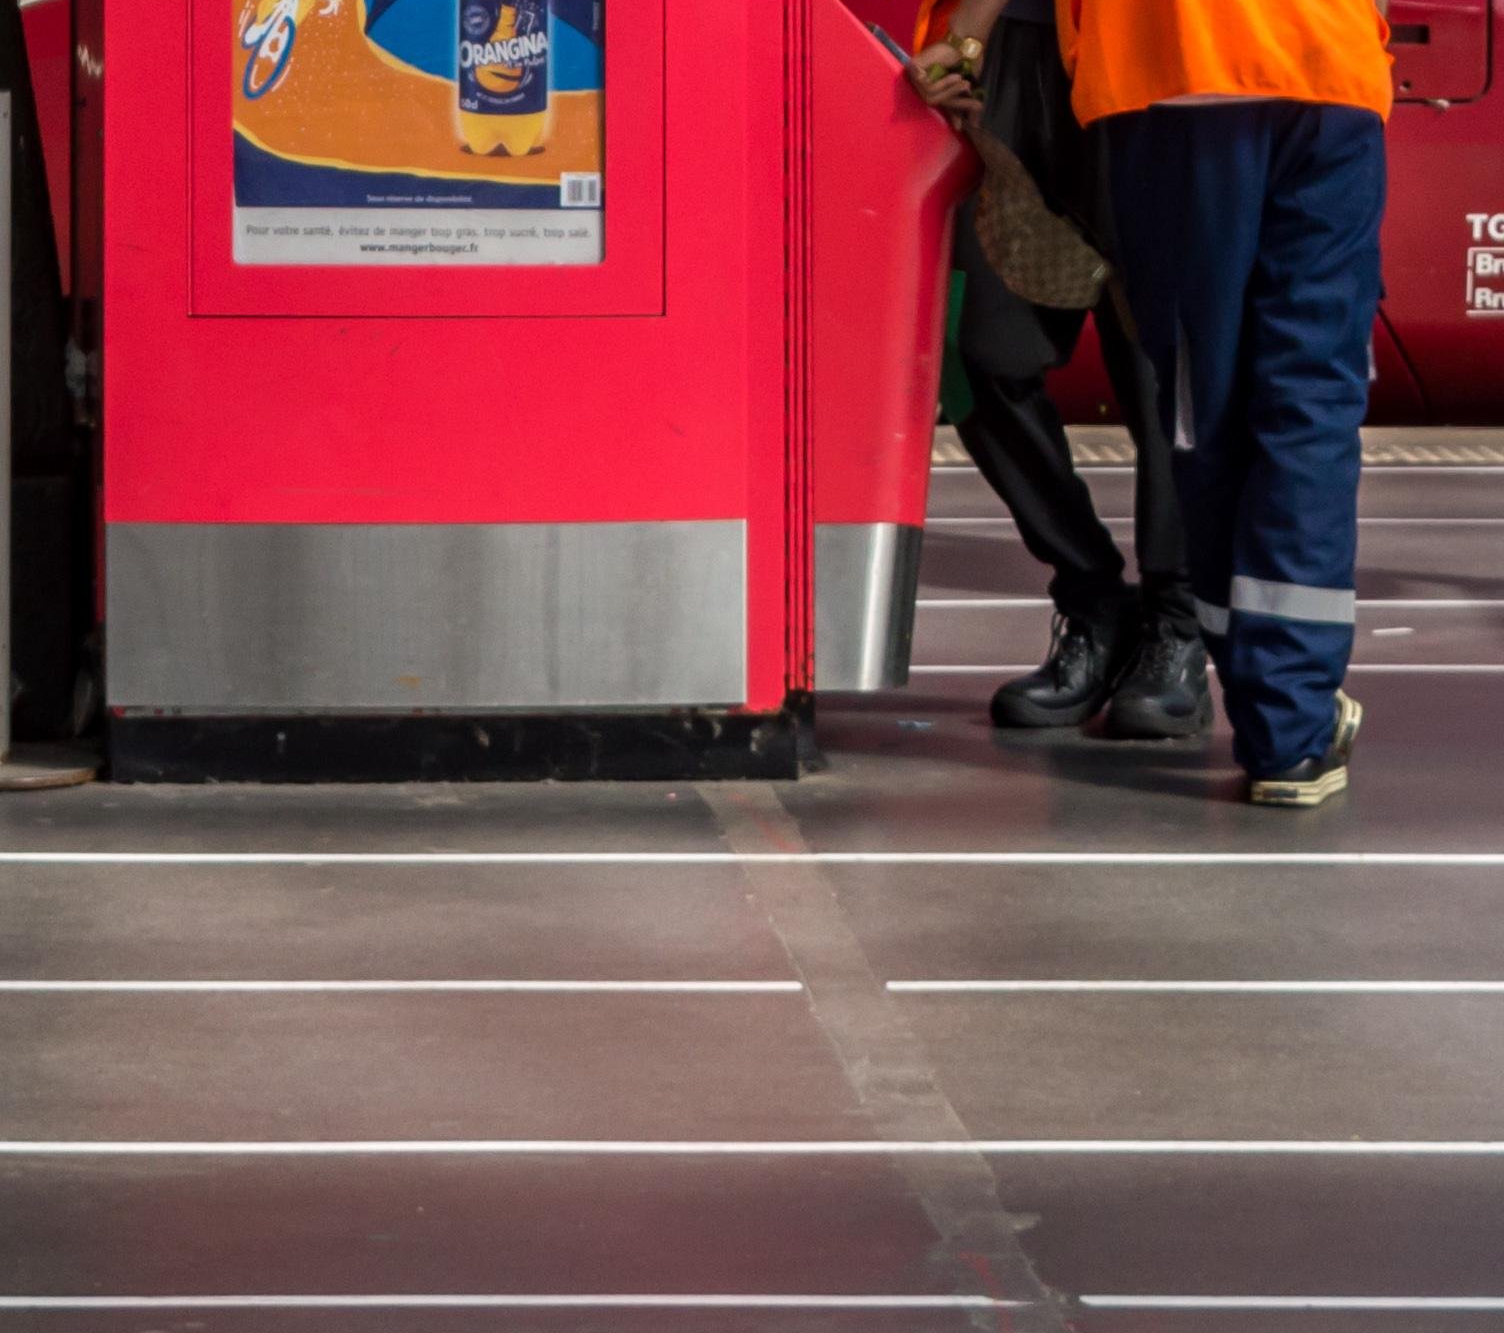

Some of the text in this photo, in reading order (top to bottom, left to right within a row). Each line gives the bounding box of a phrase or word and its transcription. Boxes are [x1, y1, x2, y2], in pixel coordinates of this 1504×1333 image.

[460, 31, 548, 69] ORANGINA
[246, 225, 269, 235] Pour
[273, 225, 299, 235] votre
[373, 225, 385, 235] de
[360, 243, 479, 255] www.mangerbouger.fr
